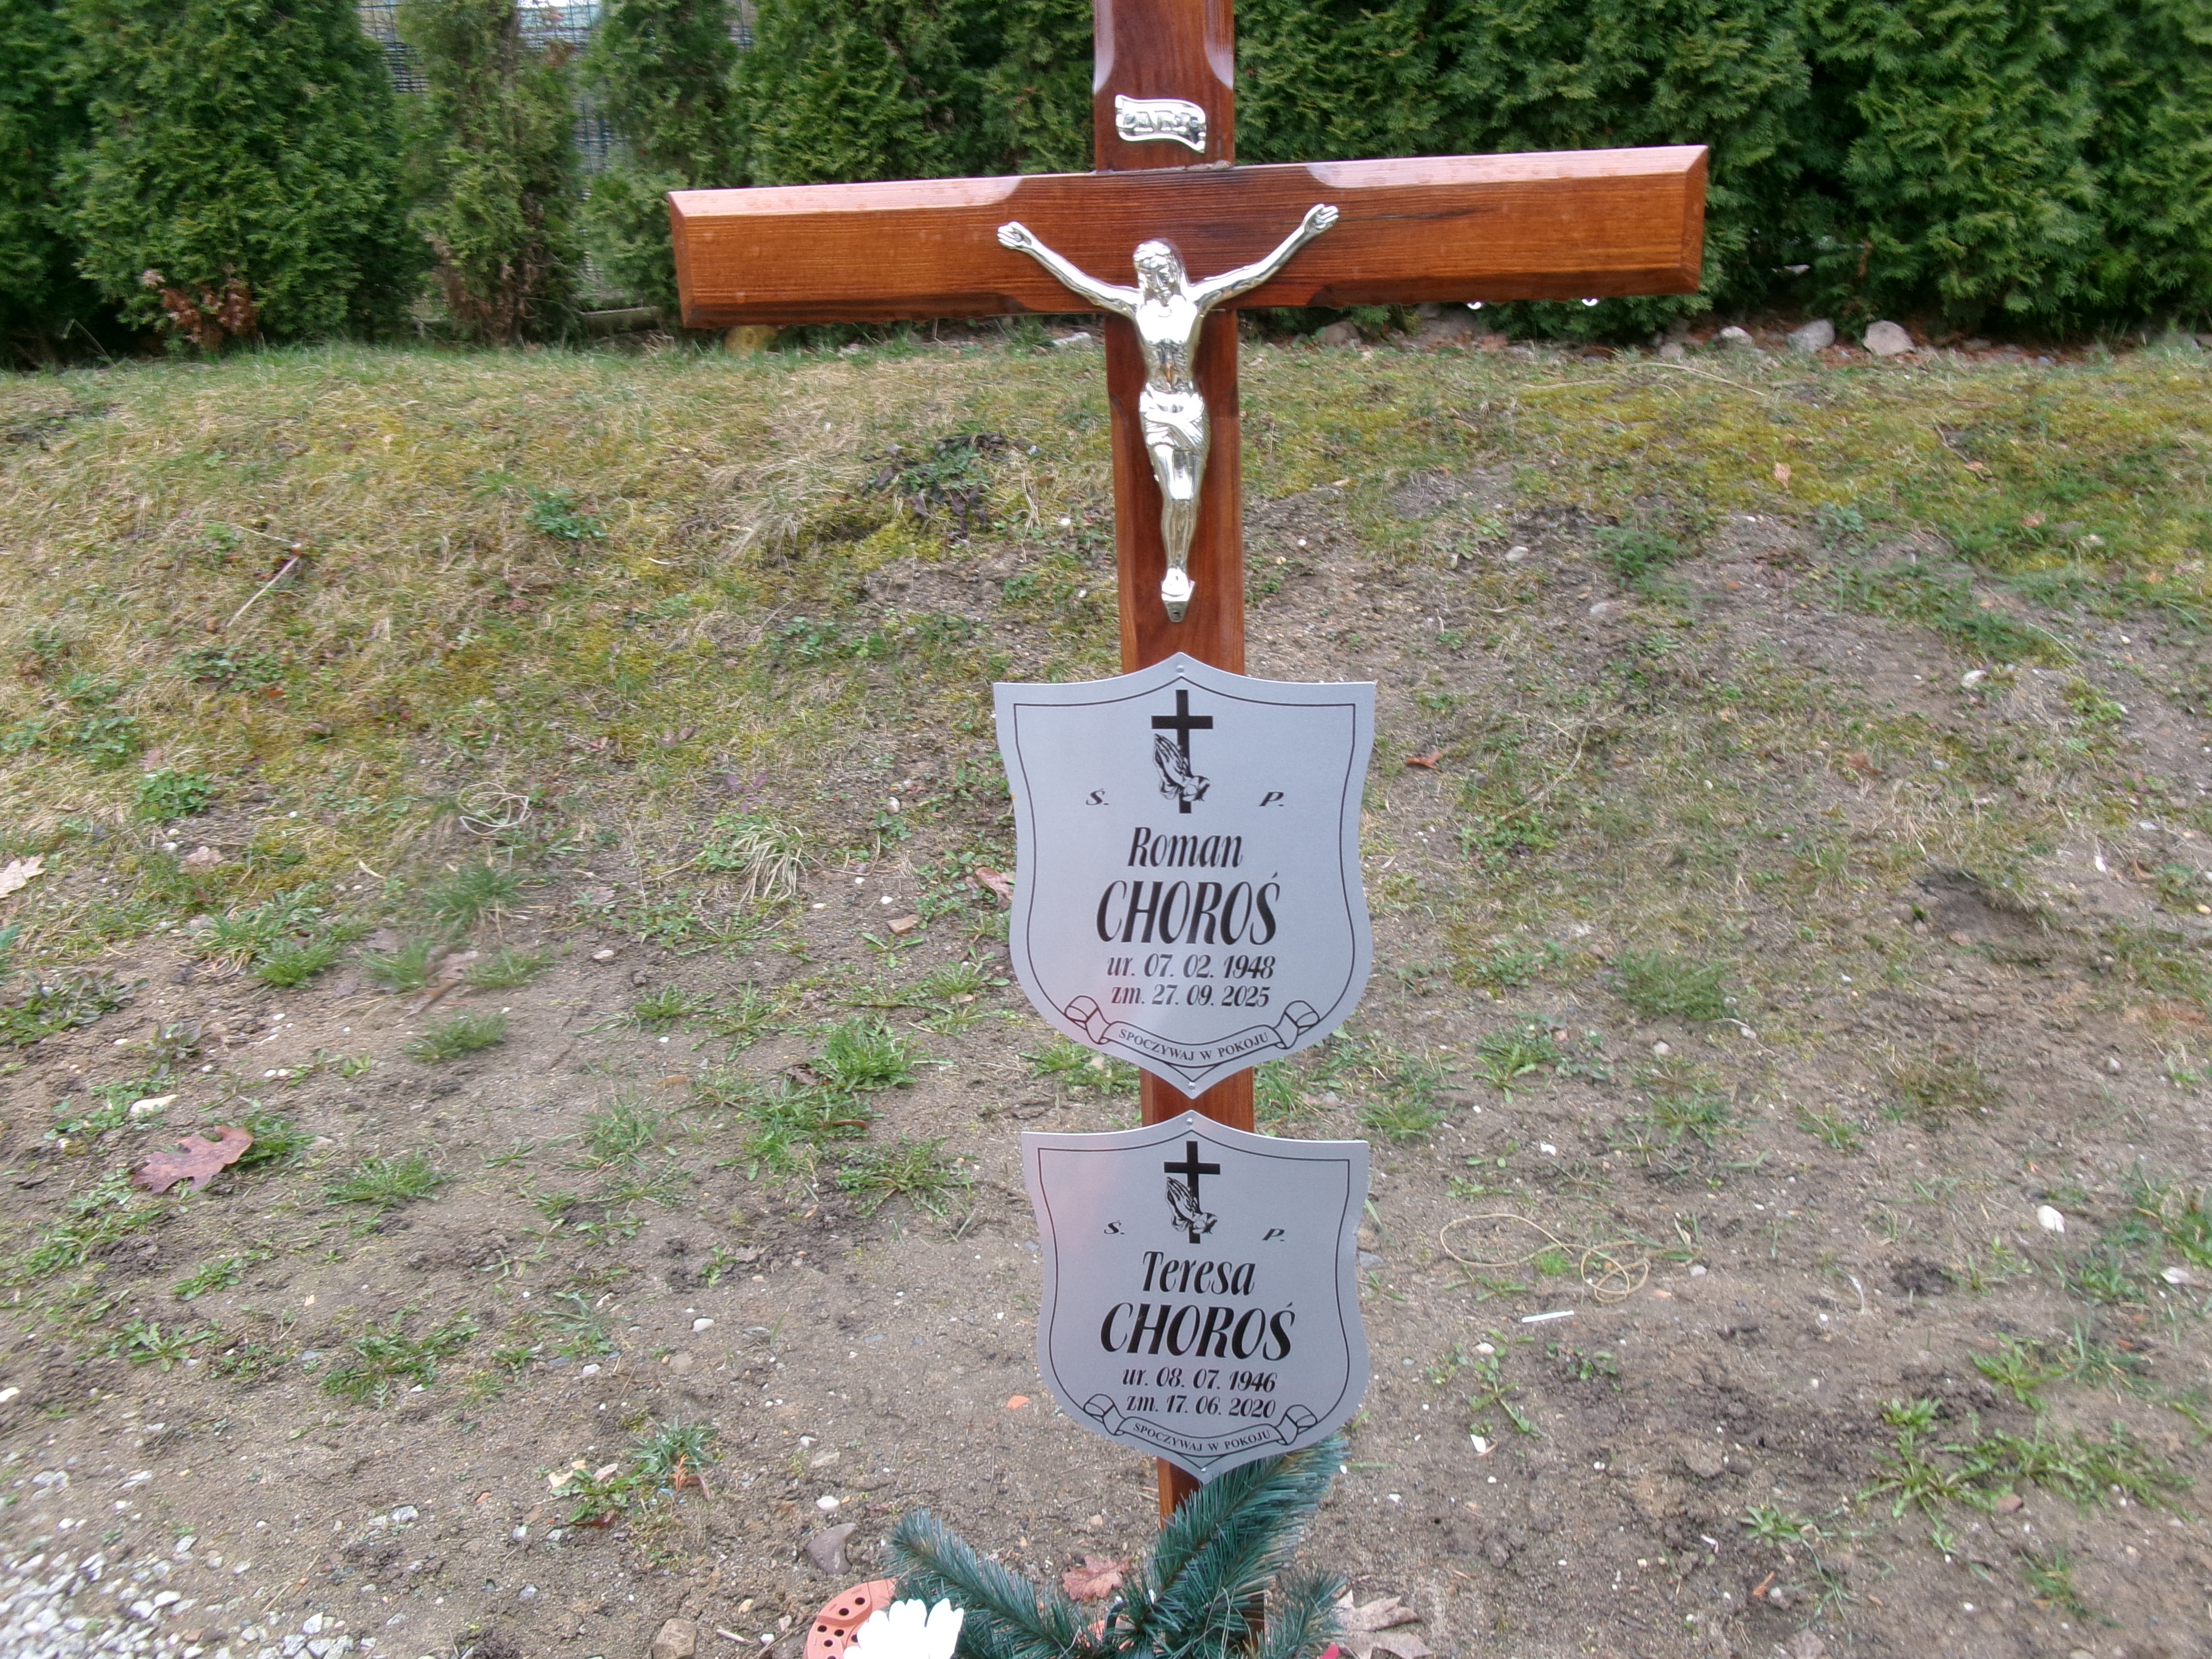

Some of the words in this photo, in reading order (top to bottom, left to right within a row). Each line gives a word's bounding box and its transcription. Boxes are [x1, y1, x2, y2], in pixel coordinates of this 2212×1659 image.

[1259, 792, 1285, 806] P.
[1128, 827, 1243, 868] Roman
[1097, 871, 1280, 945] CHOROŚ
[1107, 956, 1135, 976] ur.
[1144, 953, 1174, 977] 07.
[1183, 954, 1214, 978] 02.
[1224, 955, 1275, 979] 1948
[1111, 986, 1145, 1004] zm.
[1152, 984, 1178, 1005] 27.
[1186, 985, 1214, 1006] 09.
[1221, 985, 1270, 1007] 2025
[1119, 1029, 1194, 1061] SPOCZYWAJ
[1201, 1050, 1212, 1060] W
[1218, 1033, 1268, 1058] POKOJU
[1262, 1228, 1285, 1241] P.
[1142, 1251, 1255, 1296] Teresa
[1101, 1301, 1295, 1361] CHOROŚ
[1122, 1369, 1148, 1386] ur.
[1156, 1367, 1185, 1388] 08.
[1192, 1369, 1220, 1390] 07.
[1230, 1370, 1277, 1393] 1946
[1126, 1395, 1158, 1412] zm.
[1166, 1395, 1188, 1413] 17.
[1195, 1395, 1221, 1415] 06.
[1228, 1397, 1276, 1418] 2020
[1133, 1423, 1202, 1451] SPOCZYWAJ
[1207, 1443, 1219, 1452] W
[1225, 1430, 1271, 1450] POKOJU
